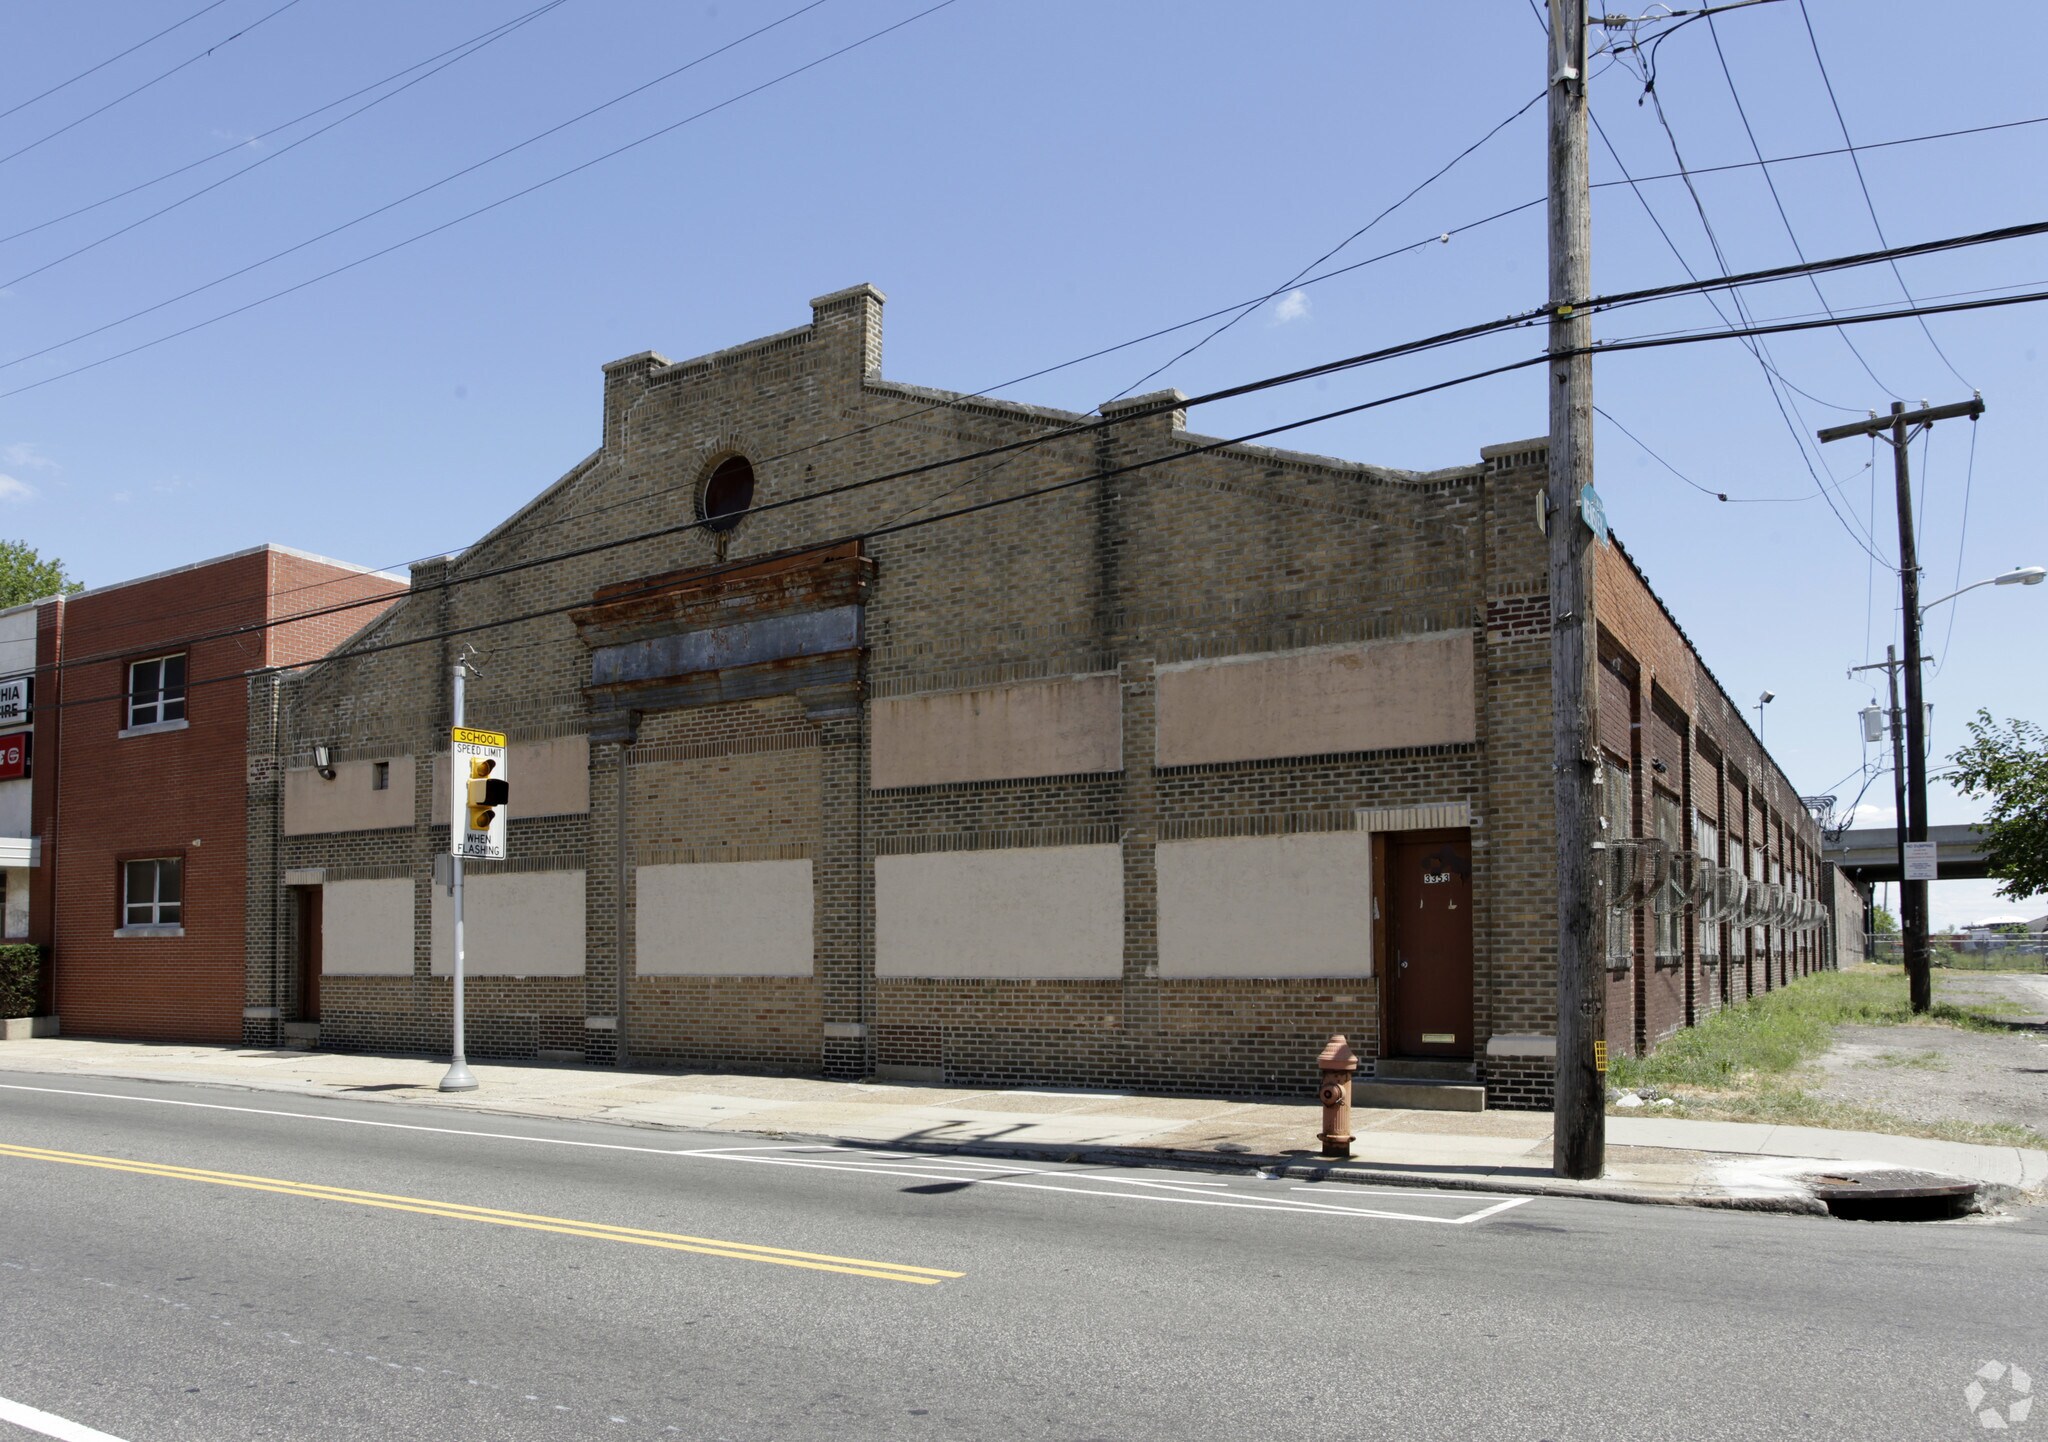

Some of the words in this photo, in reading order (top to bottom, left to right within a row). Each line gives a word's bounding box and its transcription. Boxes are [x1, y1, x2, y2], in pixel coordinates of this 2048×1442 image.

[0, 703, 18, 719] IRE
[460, 731, 500, 746] SCHOOL
[457, 743, 481, 755] SPEED
[484, 747, 502, 757] LIMIT
[467, 833, 491, 844] WHEN
[457, 843, 500, 856] FLASHING
[1425, 873, 1449, 883] 3353
